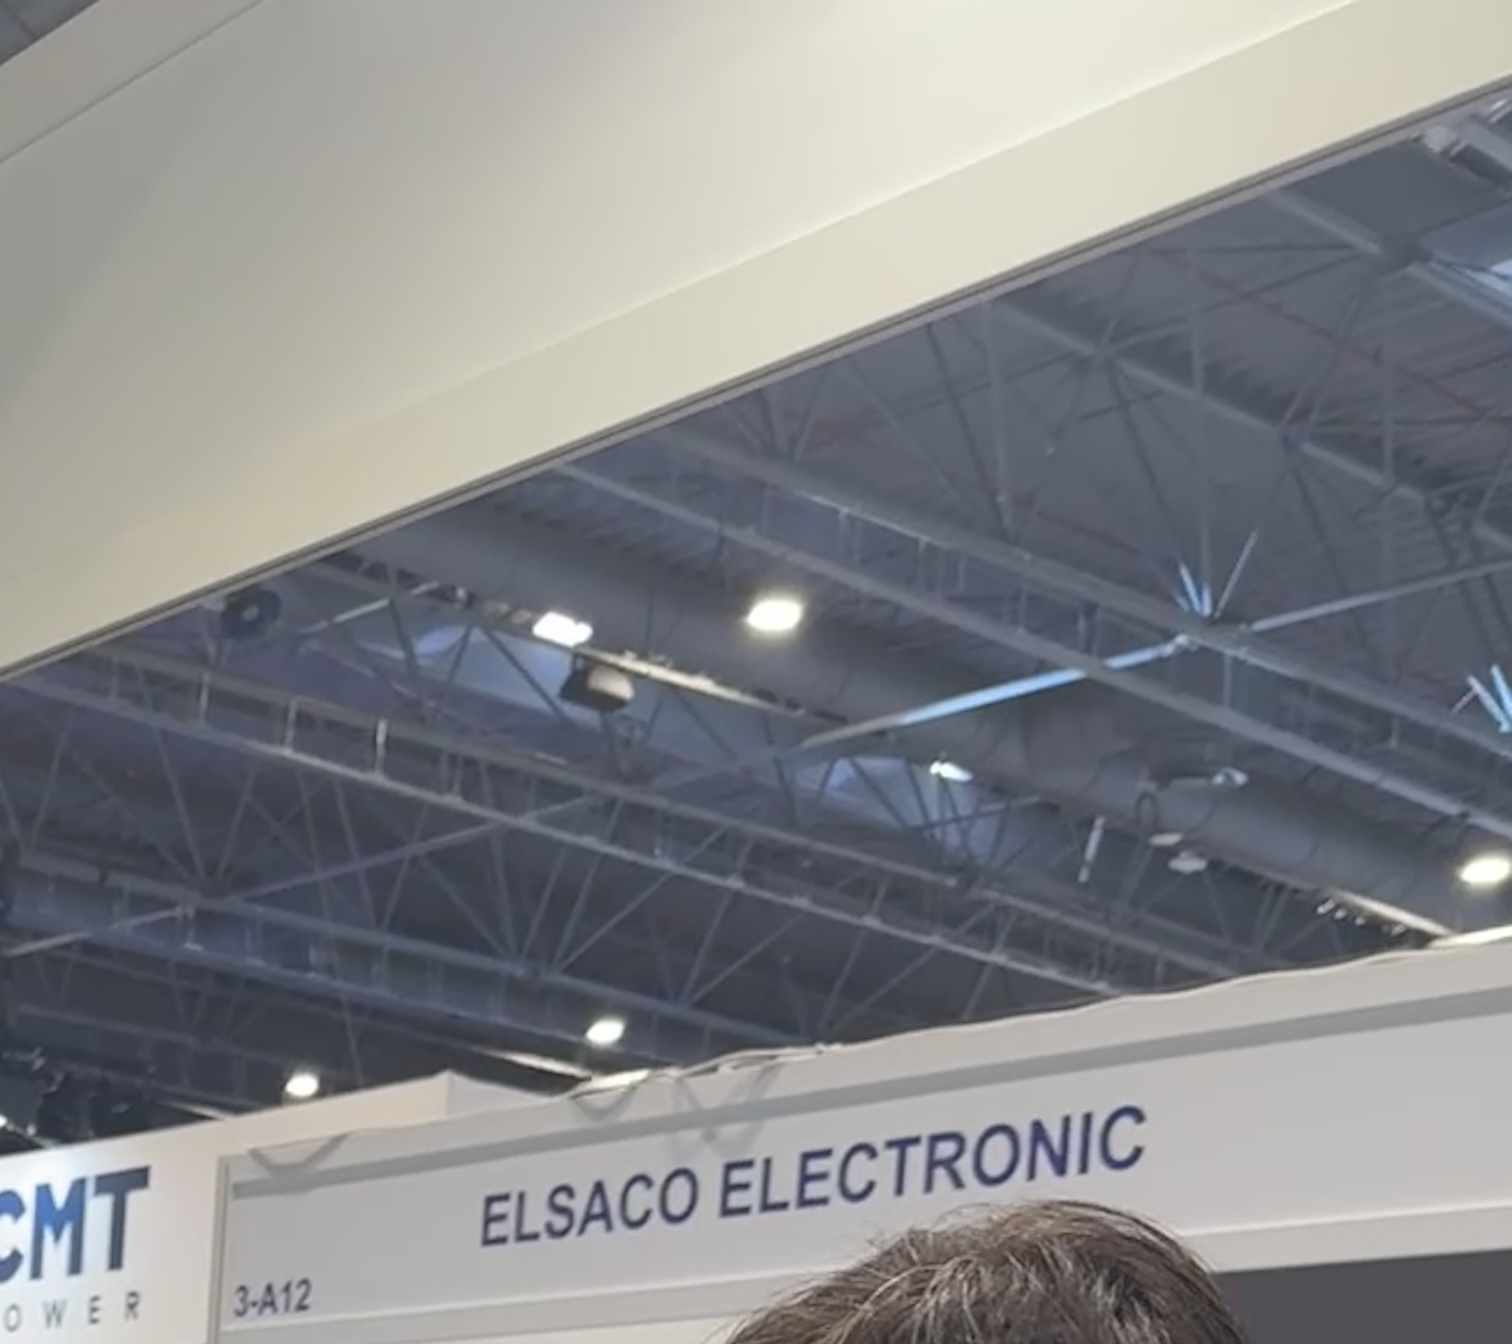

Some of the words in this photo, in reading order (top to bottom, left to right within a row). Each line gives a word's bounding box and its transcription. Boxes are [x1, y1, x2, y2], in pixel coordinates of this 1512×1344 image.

[480, 1167, 701, 1247] ELSACO
[718, 1105, 1146, 1218] ELECTRONIC
[232, 1278, 313, 1320] 3-A12
